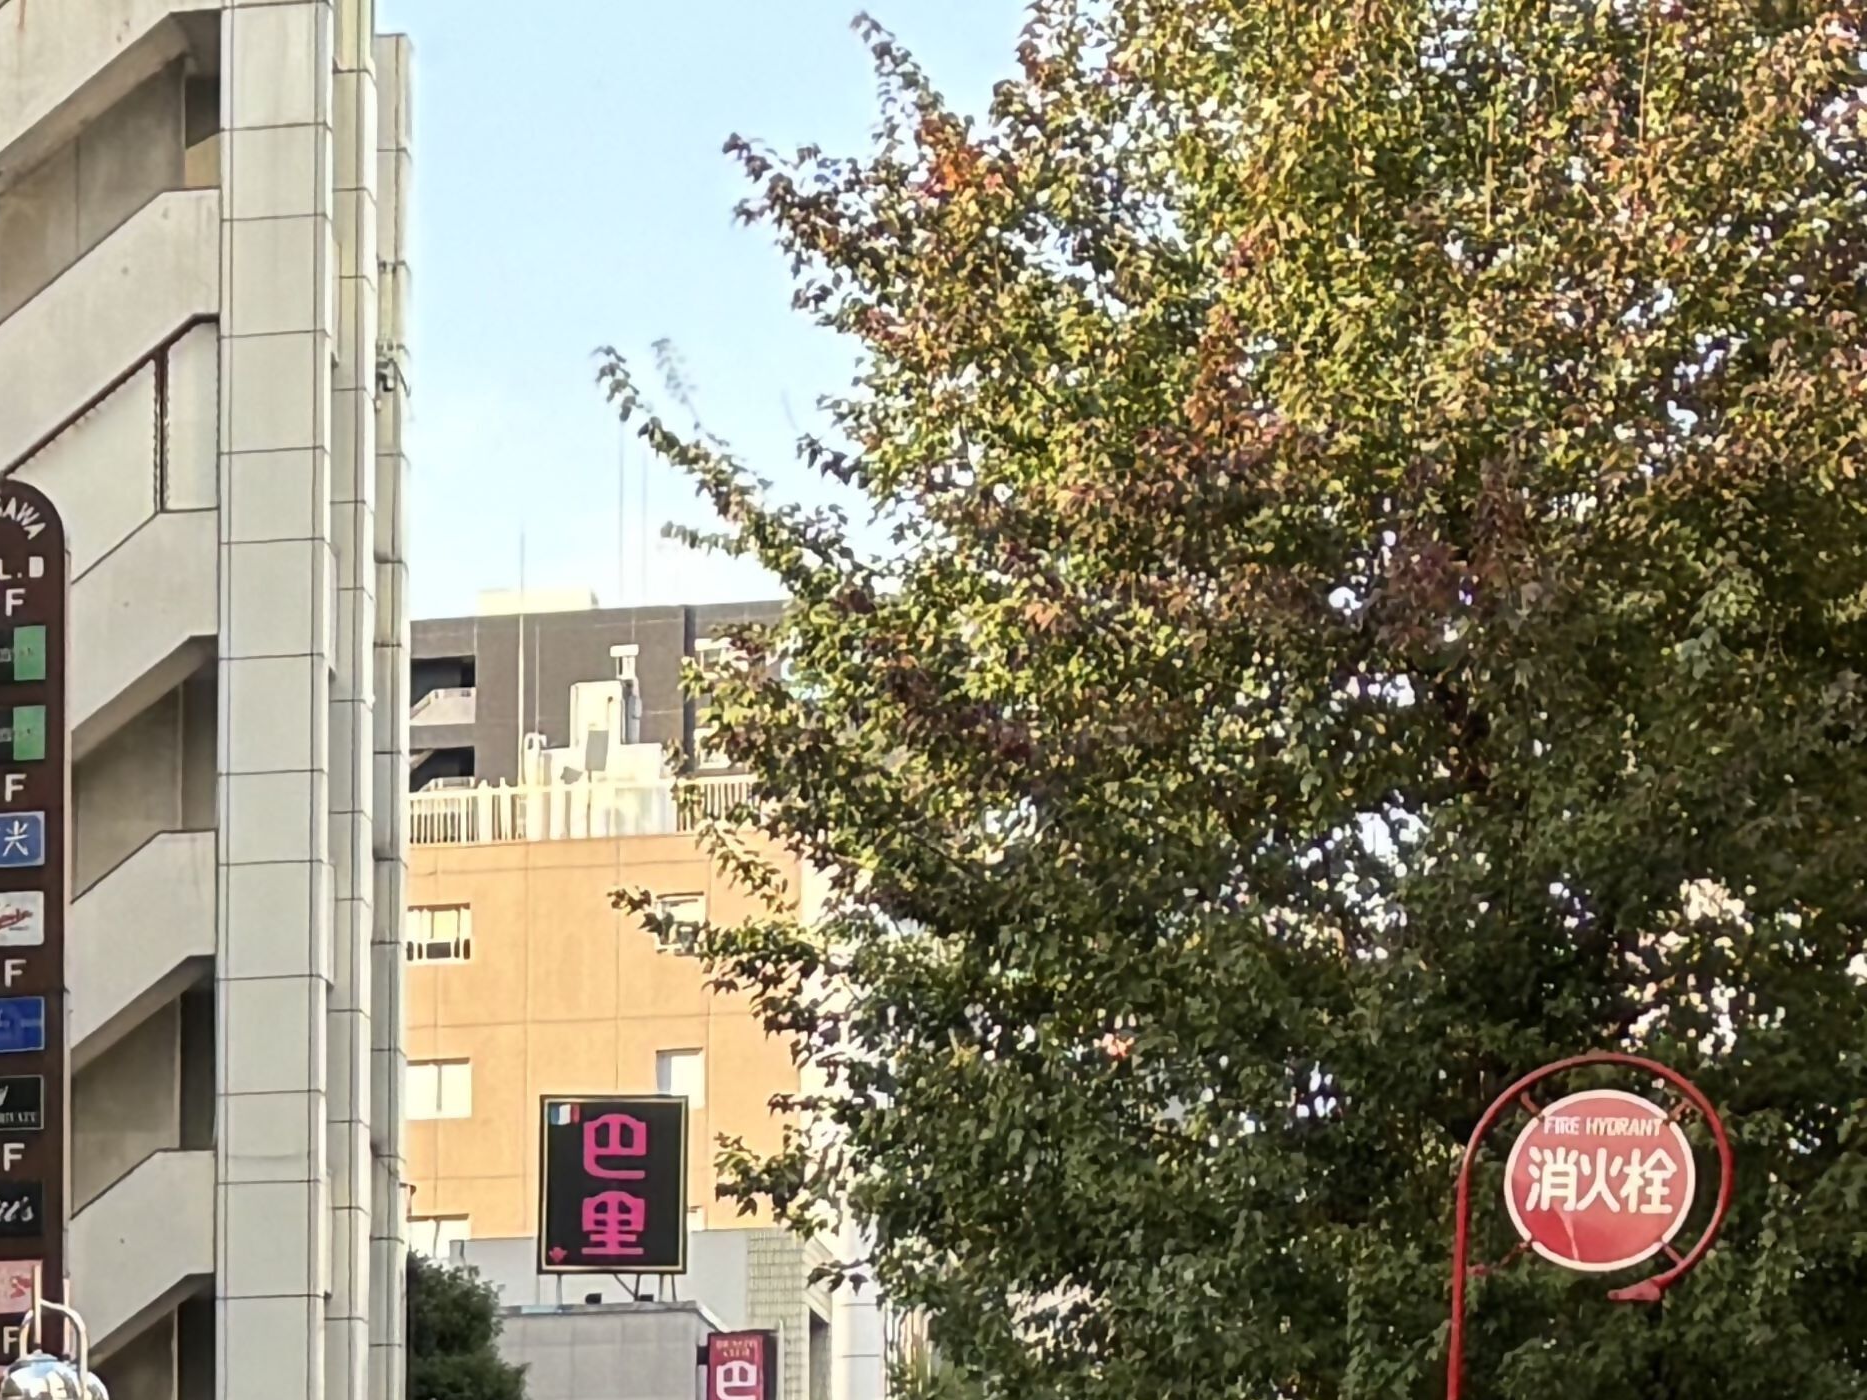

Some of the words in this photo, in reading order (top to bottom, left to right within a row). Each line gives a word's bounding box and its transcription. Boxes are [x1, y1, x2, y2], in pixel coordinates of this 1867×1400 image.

[1543, 1115, 1580, 1136] FIRE
[1585, 1116, 1665, 1137] HYDRANT
[580, 1112, 648, 1257] 巴里
[1525, 1146, 1678, 1215] 消火栓
